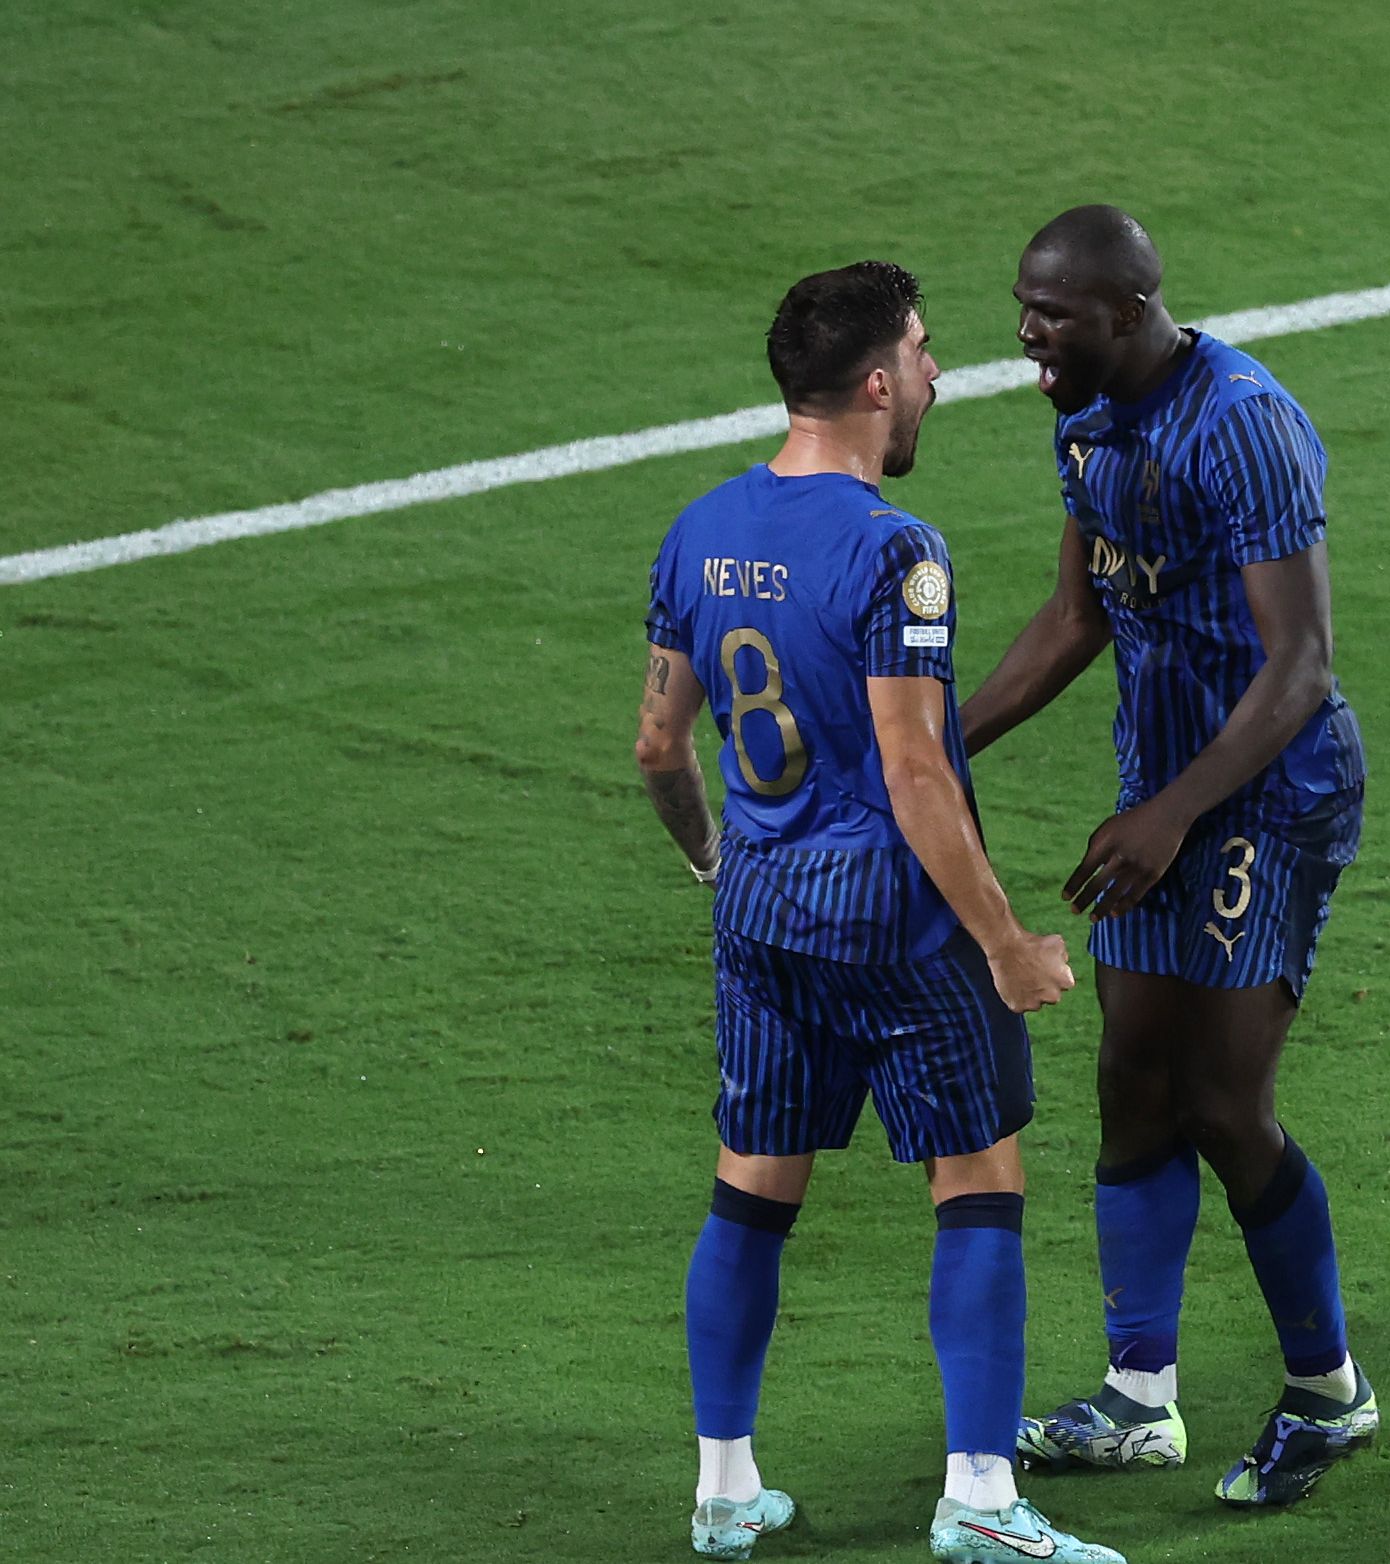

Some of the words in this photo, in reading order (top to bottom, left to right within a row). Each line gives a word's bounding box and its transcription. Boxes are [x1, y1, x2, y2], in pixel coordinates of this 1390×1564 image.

[703, 558, 789, 602] NEVES
[922, 605, 940, 615] FIFA
[720, 627, 809, 796] 8
[1212, 836, 1256, 920] 3
